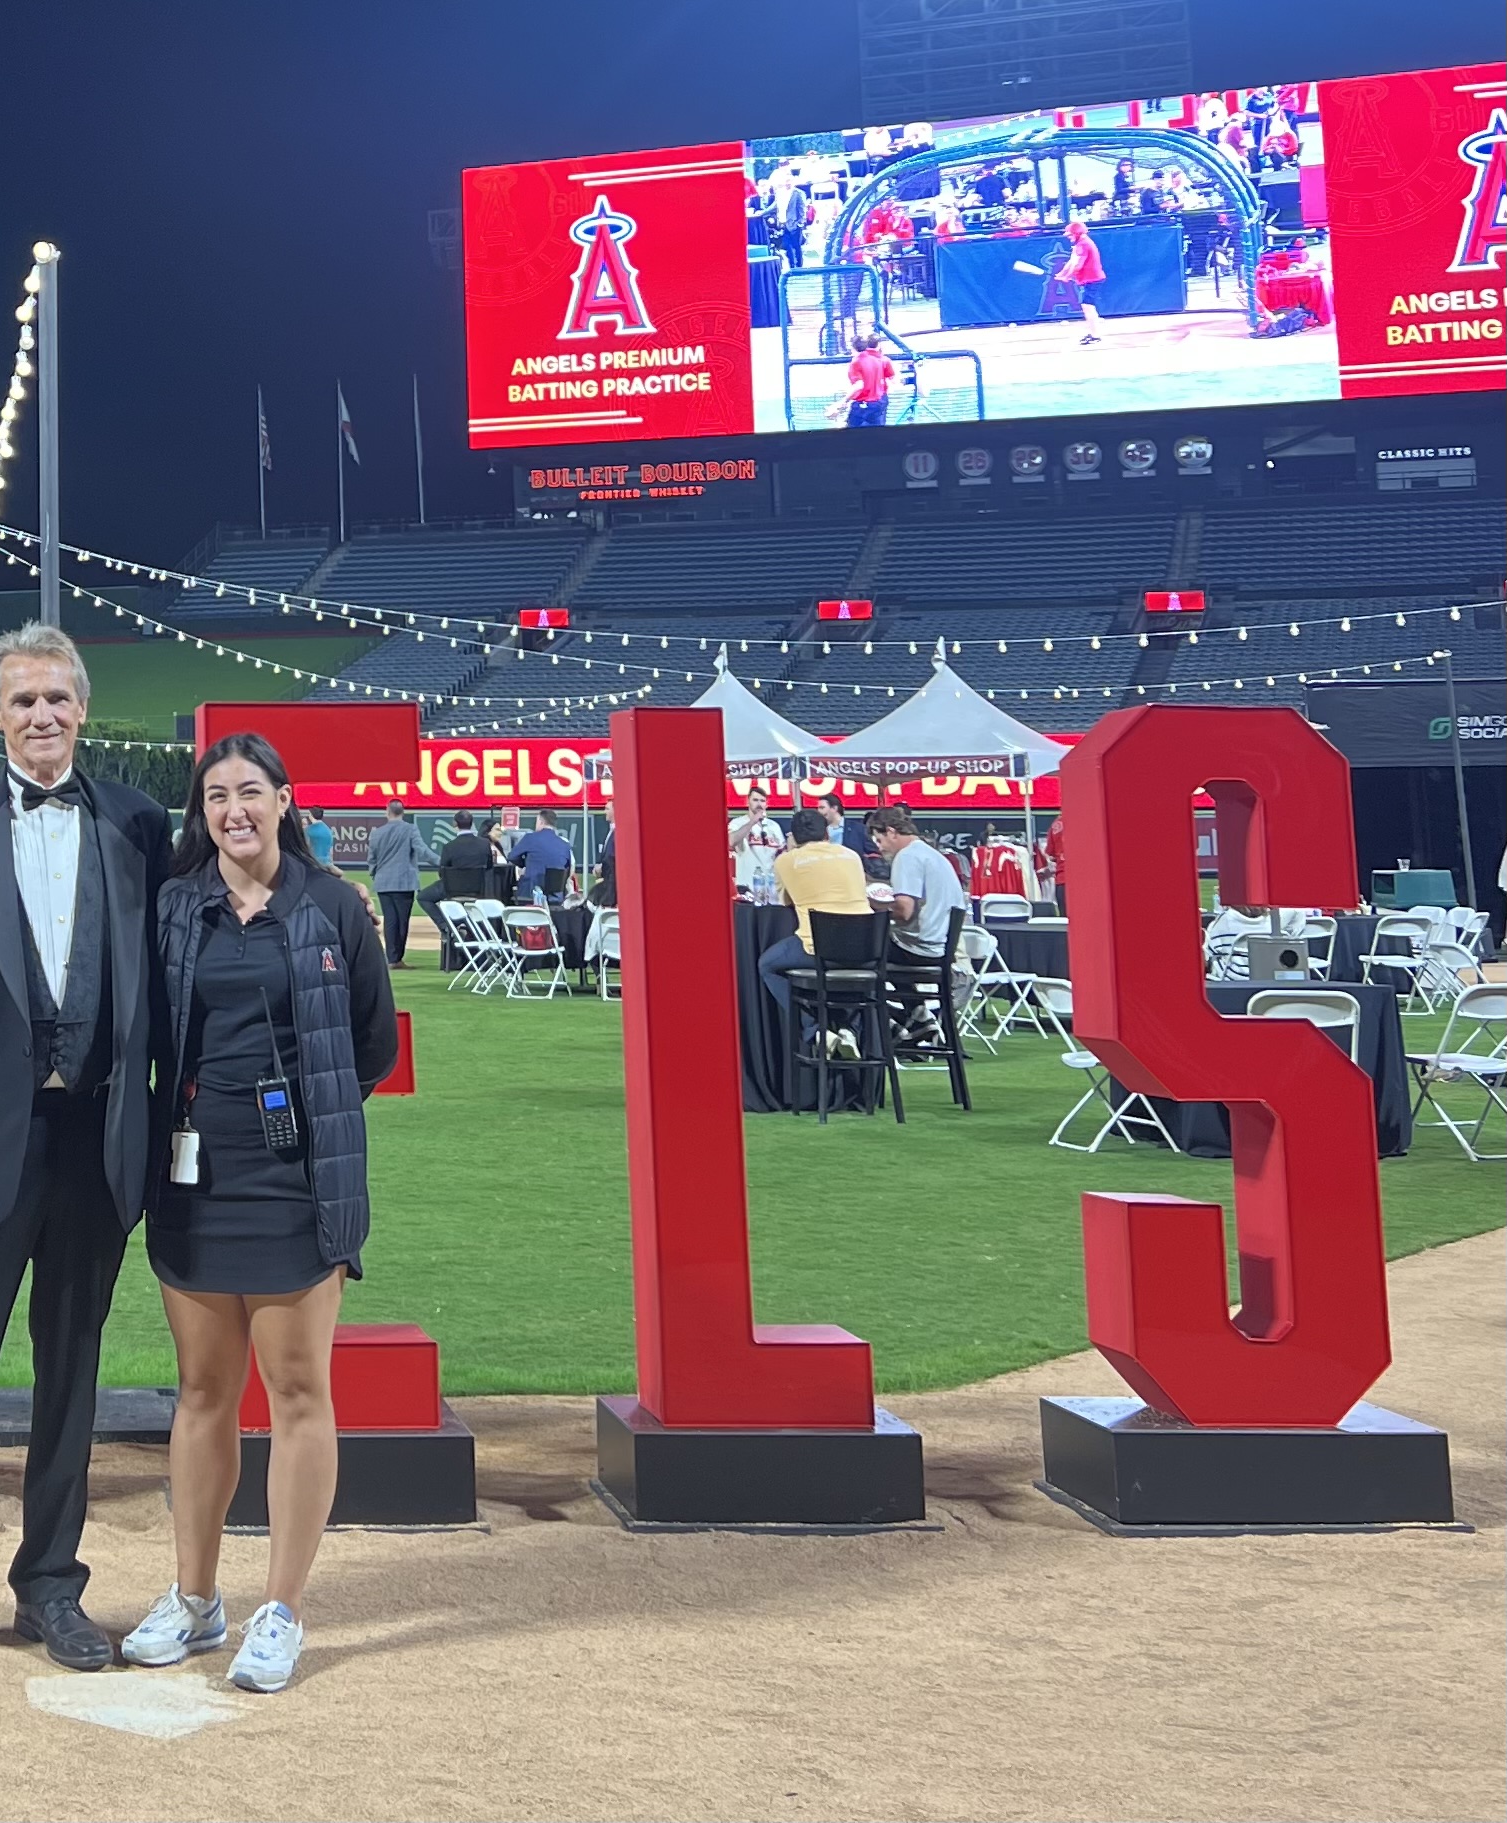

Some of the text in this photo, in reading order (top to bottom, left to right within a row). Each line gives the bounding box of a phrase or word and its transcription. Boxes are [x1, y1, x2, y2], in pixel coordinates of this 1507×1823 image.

[1389, 288, 1498, 316] ANGELS
[1386, 319, 1502, 346] BATTING
[511, 345, 705, 376] ANGELS PREMIUM
[507, 372, 711, 403] BATTING PRACTICE
[1377, 447, 1472, 460] CLASSIC HITS
[530, 459, 756, 489] BULLEIT BOURBON
[353, 748, 583, 796] NGELS
[728, 762, 773, 776] SHOP
[816, 759, 1004, 776] ANGELS POP-UP SHOP
